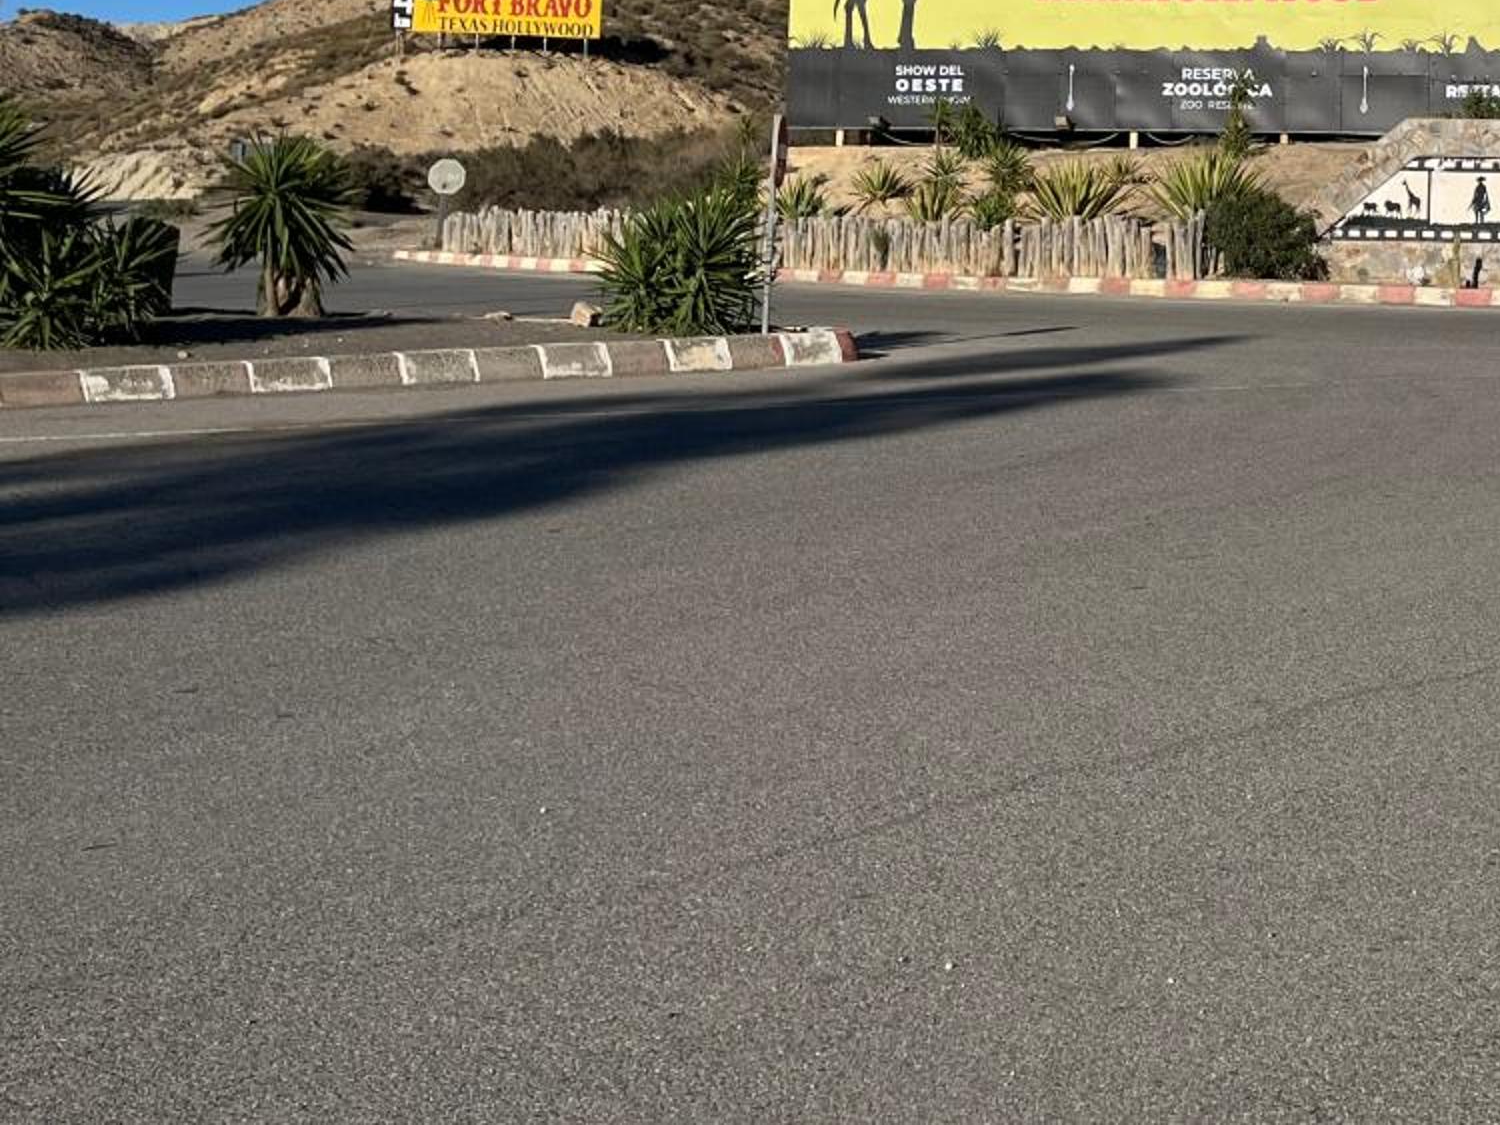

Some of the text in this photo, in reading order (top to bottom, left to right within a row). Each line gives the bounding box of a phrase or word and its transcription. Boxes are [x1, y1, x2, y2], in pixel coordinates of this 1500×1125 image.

[440, 17, 594, 37] TEXAS HOLLYWOOD
[895, 64, 964, 76] SHOW DEL
[895, 78, 964, 92] OESTE
[1161, 79, 1274, 98] ZOOLÓCA
